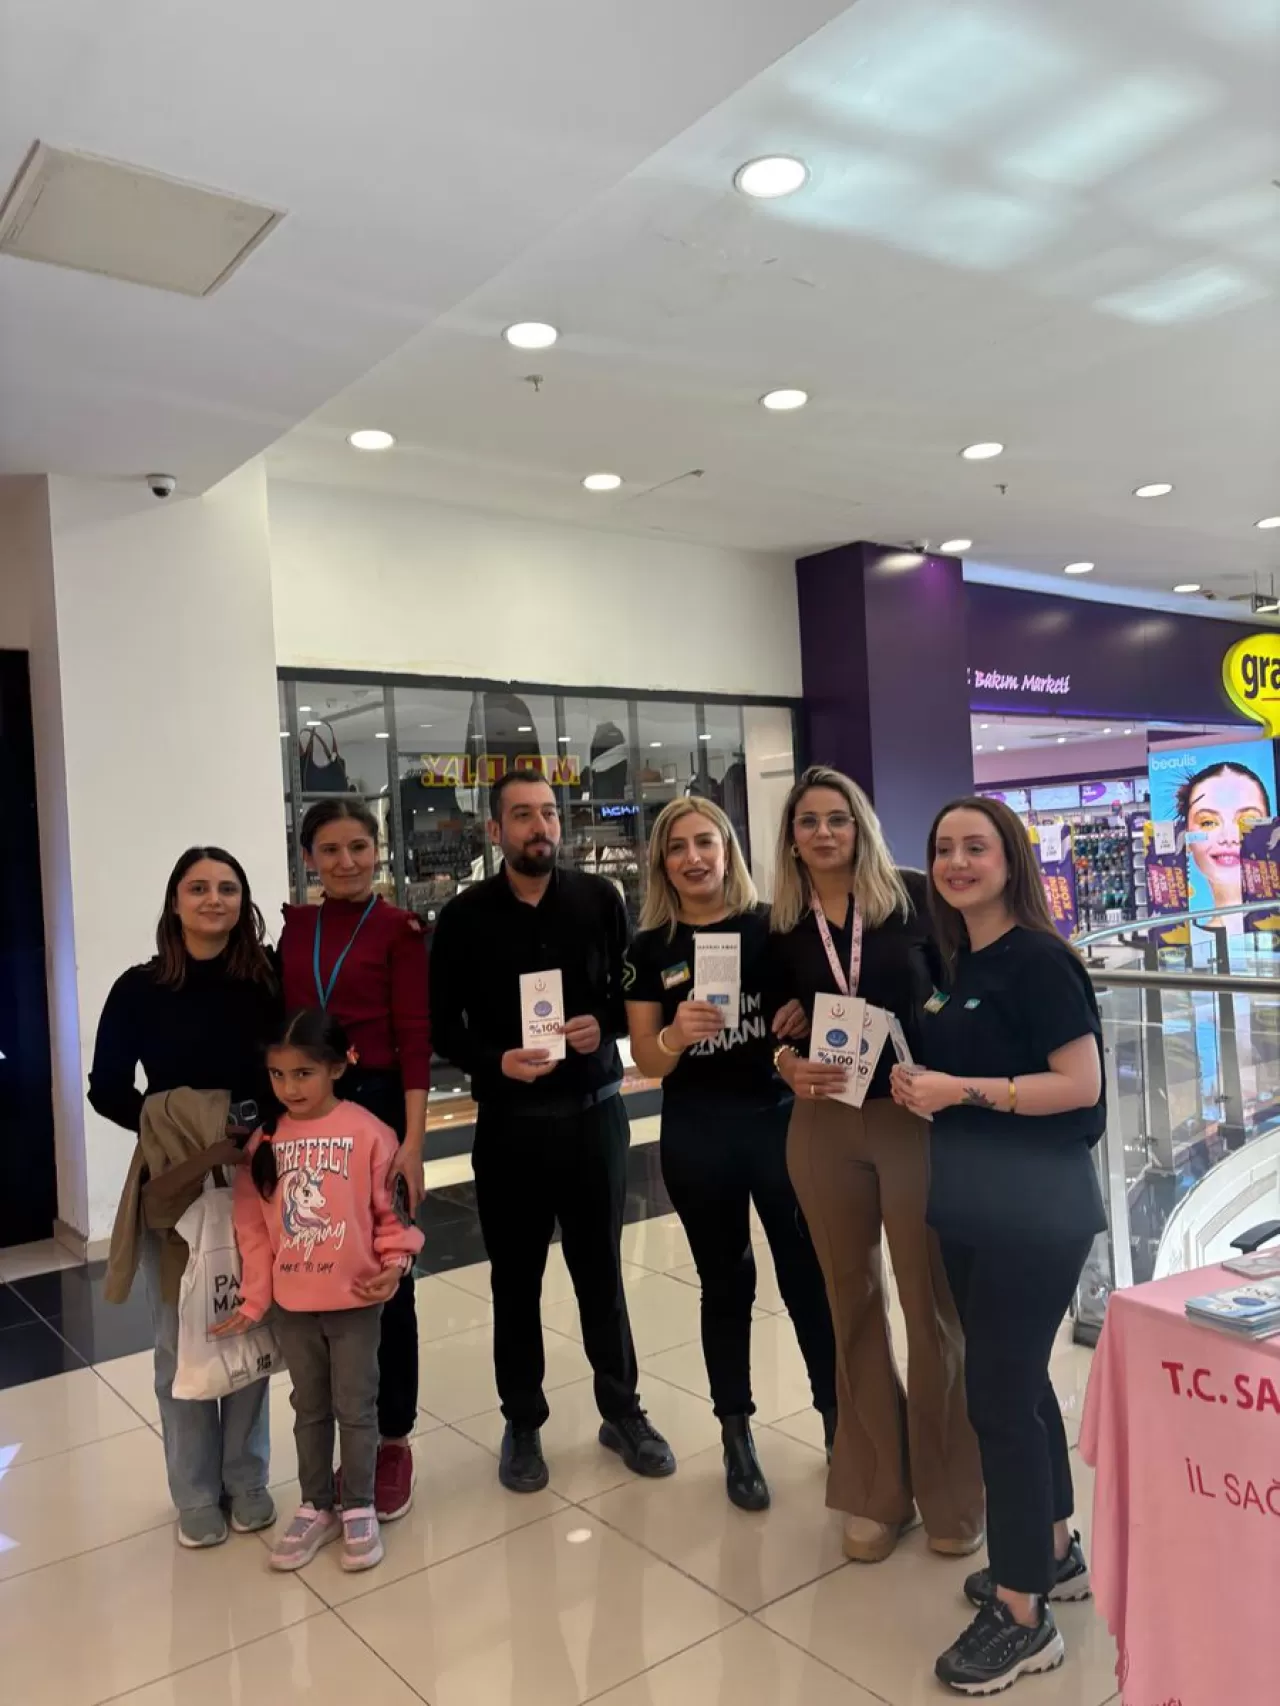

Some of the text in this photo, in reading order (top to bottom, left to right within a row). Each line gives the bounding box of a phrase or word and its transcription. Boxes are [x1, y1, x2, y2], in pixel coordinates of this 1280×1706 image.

[1021, 674, 1070, 694] Marketi
[690, 1015, 766, 1056] ZMANI
[818, 1051, 853, 1066] %100
[272, 1136, 354, 1180] ERFFECT
[1185, 1457, 1216, 1498] İL
